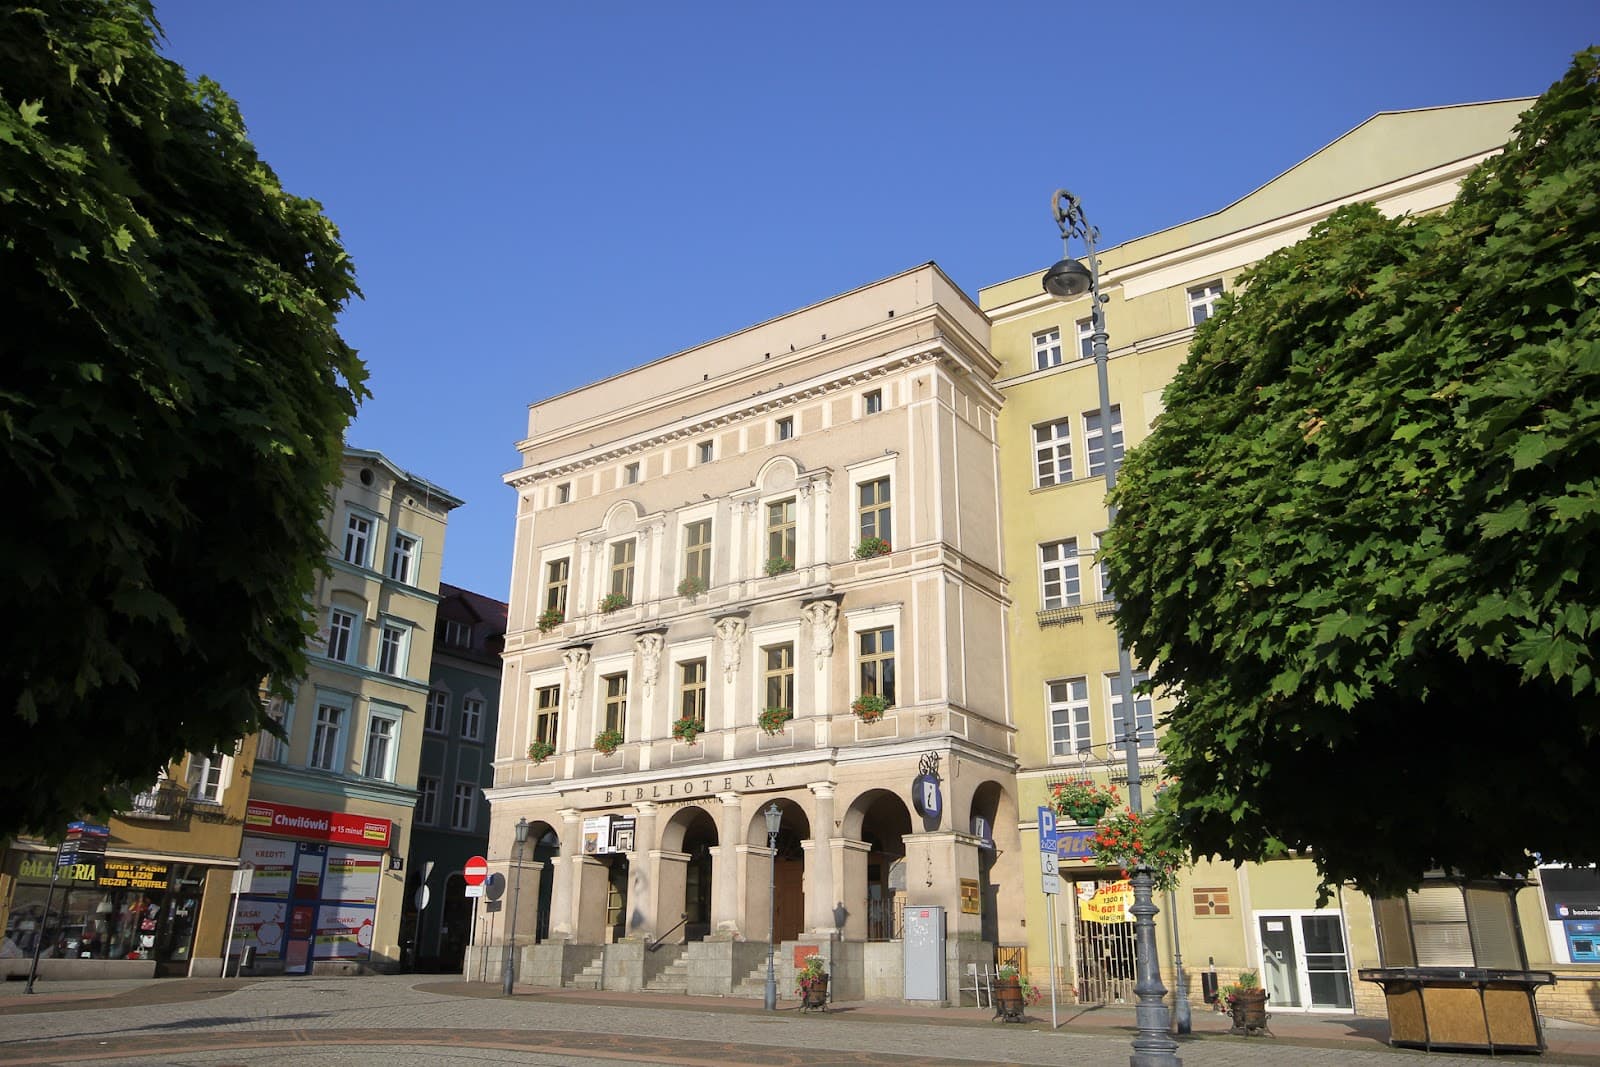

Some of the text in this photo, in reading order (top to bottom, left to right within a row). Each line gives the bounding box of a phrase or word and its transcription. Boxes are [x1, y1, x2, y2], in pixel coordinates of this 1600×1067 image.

[606, 773, 775, 802] BIBLIOTEKA
[275, 814, 328, 831] Chwilówki
[1042, 811, 1053, 838] P
[117, 870, 153, 880] WALIZKI
[99, 877, 127, 887] TECZKI
[131, 879, 168, 888] PORTFELE
[1101, 905, 1115, 913] 601
